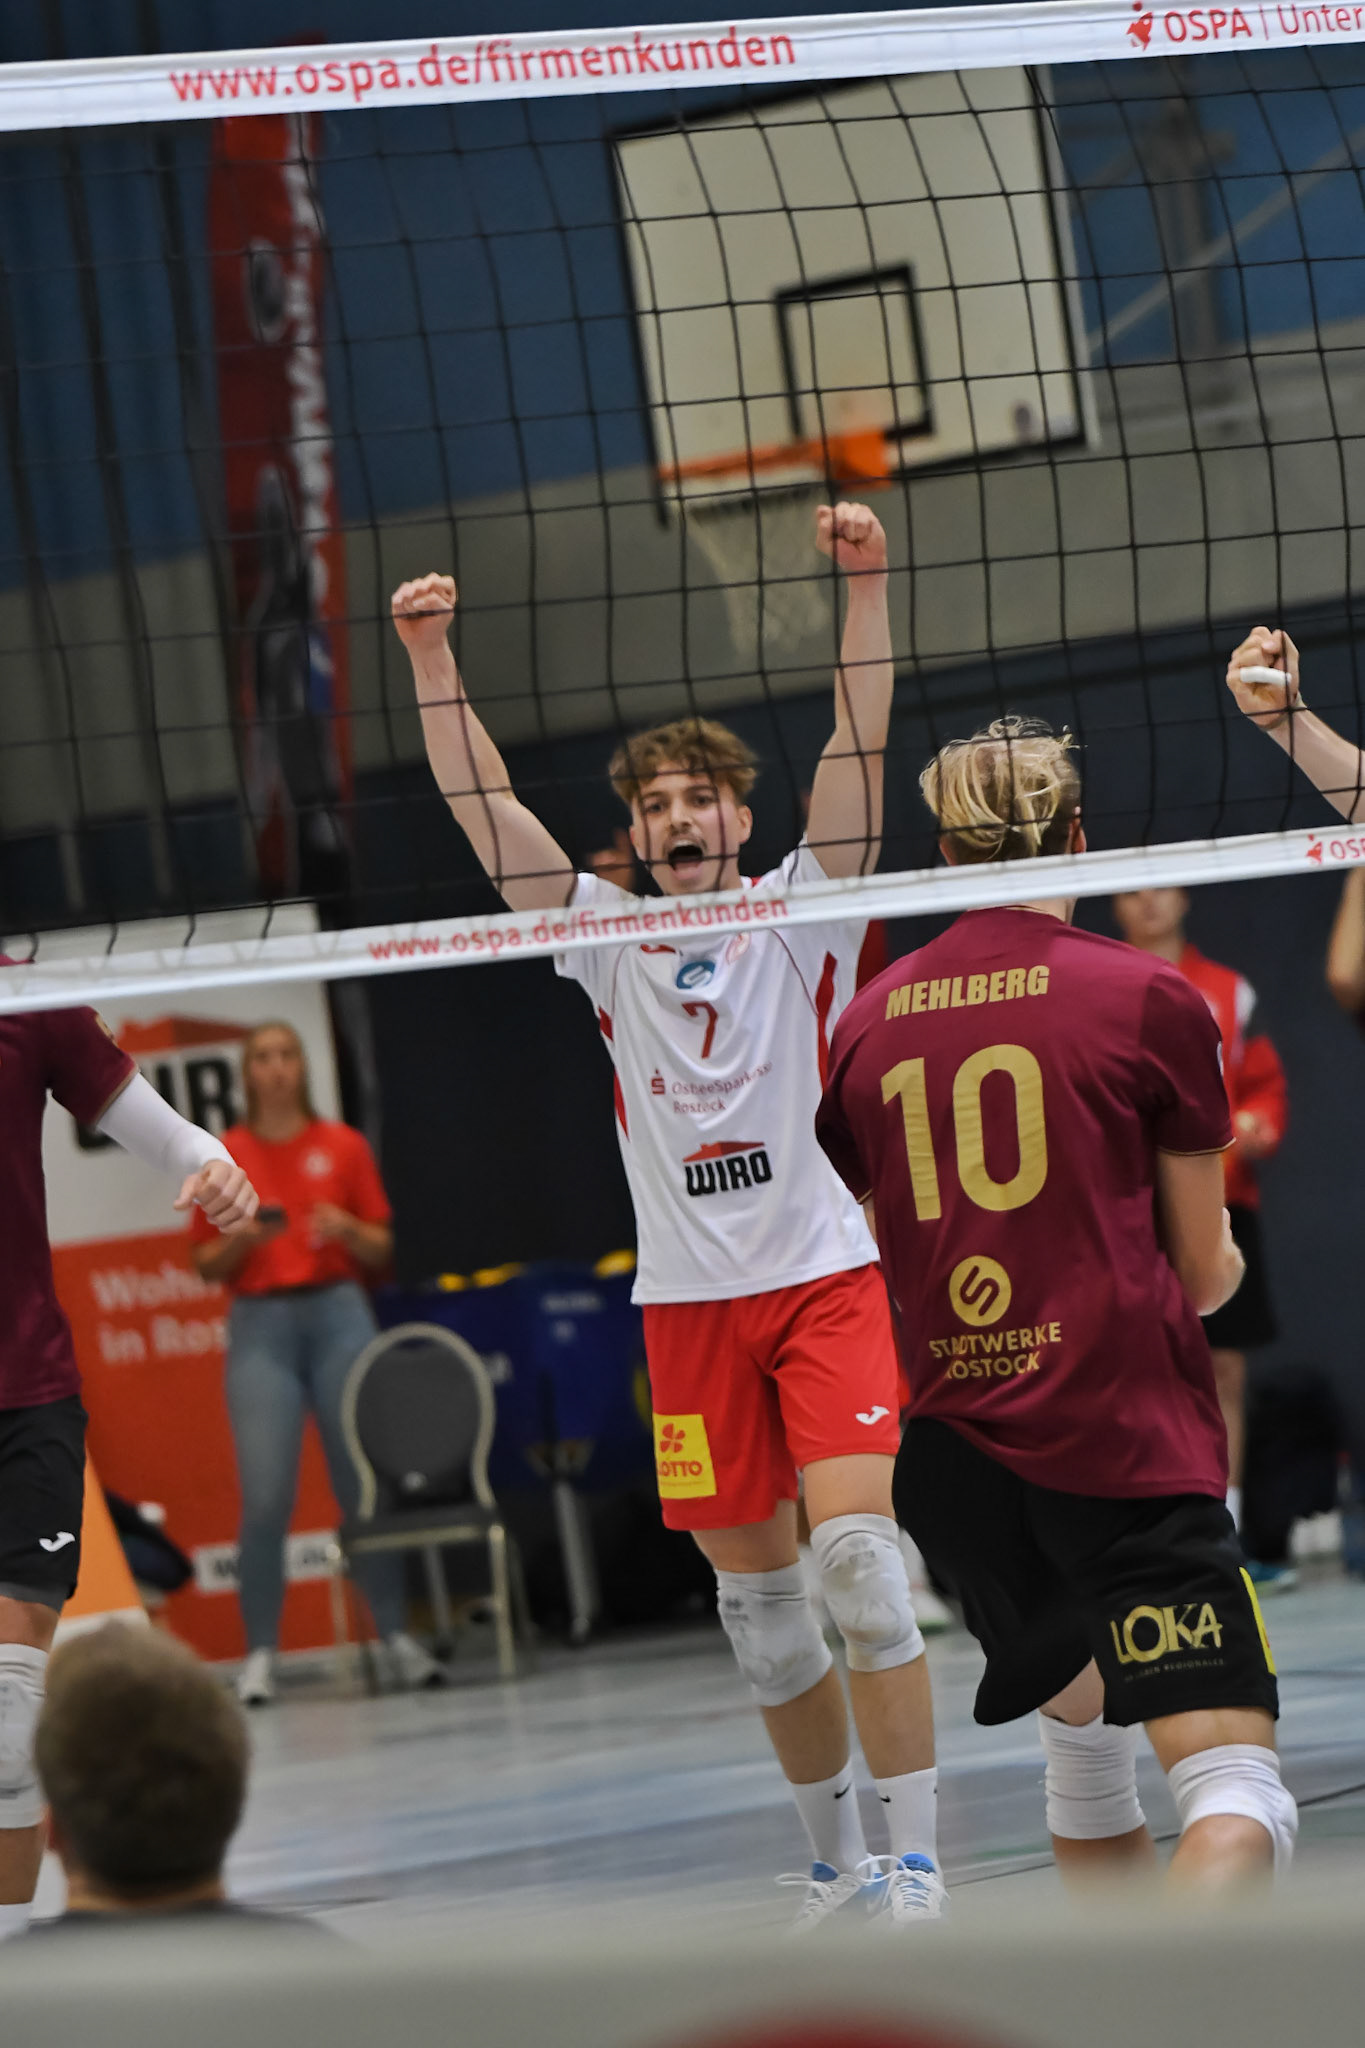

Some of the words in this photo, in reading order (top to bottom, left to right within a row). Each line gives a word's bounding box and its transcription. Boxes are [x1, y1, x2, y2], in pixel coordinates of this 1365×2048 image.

[1164, 8, 1252, 42] OSPA
[1278, 4, 1365, 34] Unter
[170, 26, 796, 102] www.ospa.de/firmenkunden
[369, 898, 788, 959] www.ospa.de/firmenkunden
[885, 965, 1050, 1021] MEHLBERG
[681, 1001, 718, 1059] 7
[672, 1062, 773, 1095] OsteeSparkss
[880, 1043, 1048, 1221] 10
[685, 1150, 773, 1197] WIRO
[659, 1461, 702, 1477] OTTO
[1110, 1602, 1223, 1664] LOKA
